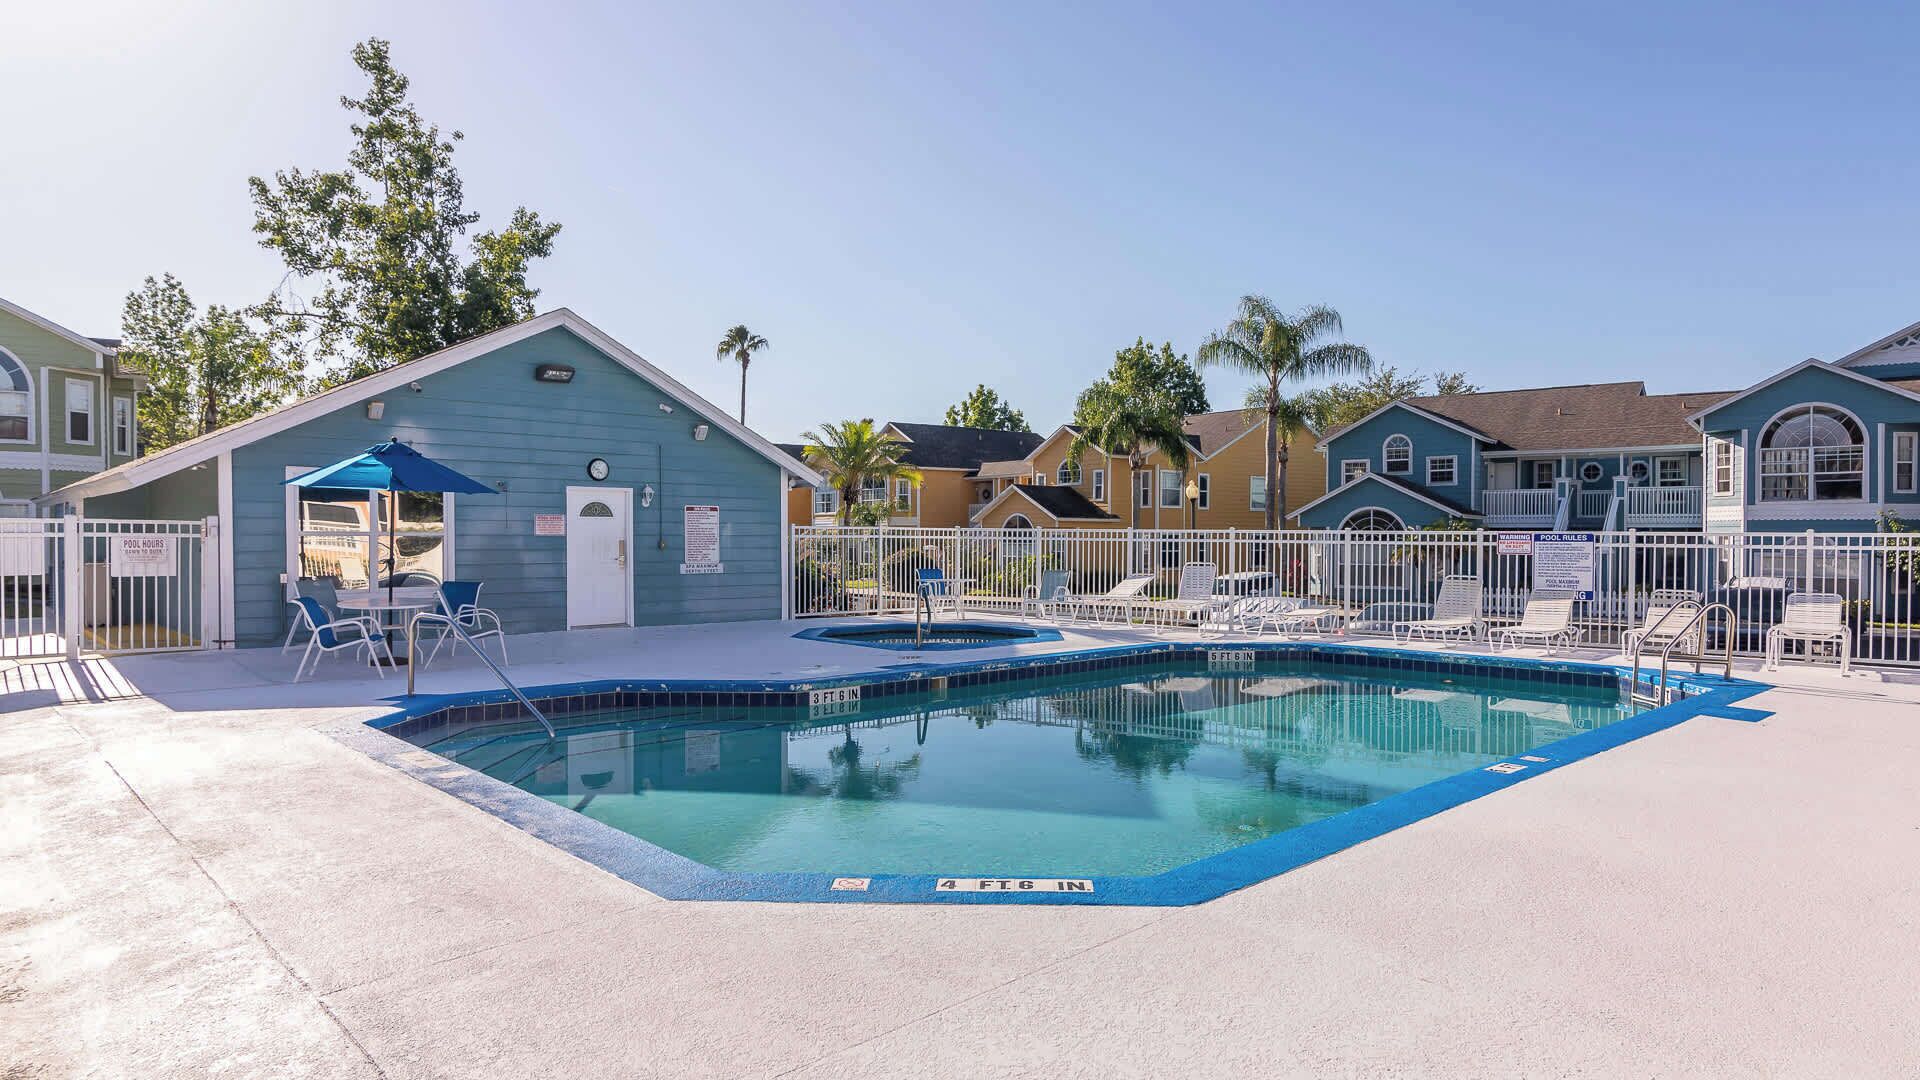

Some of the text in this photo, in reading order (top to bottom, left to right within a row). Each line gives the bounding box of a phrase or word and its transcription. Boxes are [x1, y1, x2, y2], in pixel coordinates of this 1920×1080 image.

[123, 539, 164, 549] POOL HOURS
[1211, 652, 1217, 661] 5
[1234, 652, 1240, 661] 6
[813, 693, 819, 704] 3
[839, 690, 845, 701] 6
[940, 880, 957, 889] 4
[1018, 880, 1034, 889] 6
